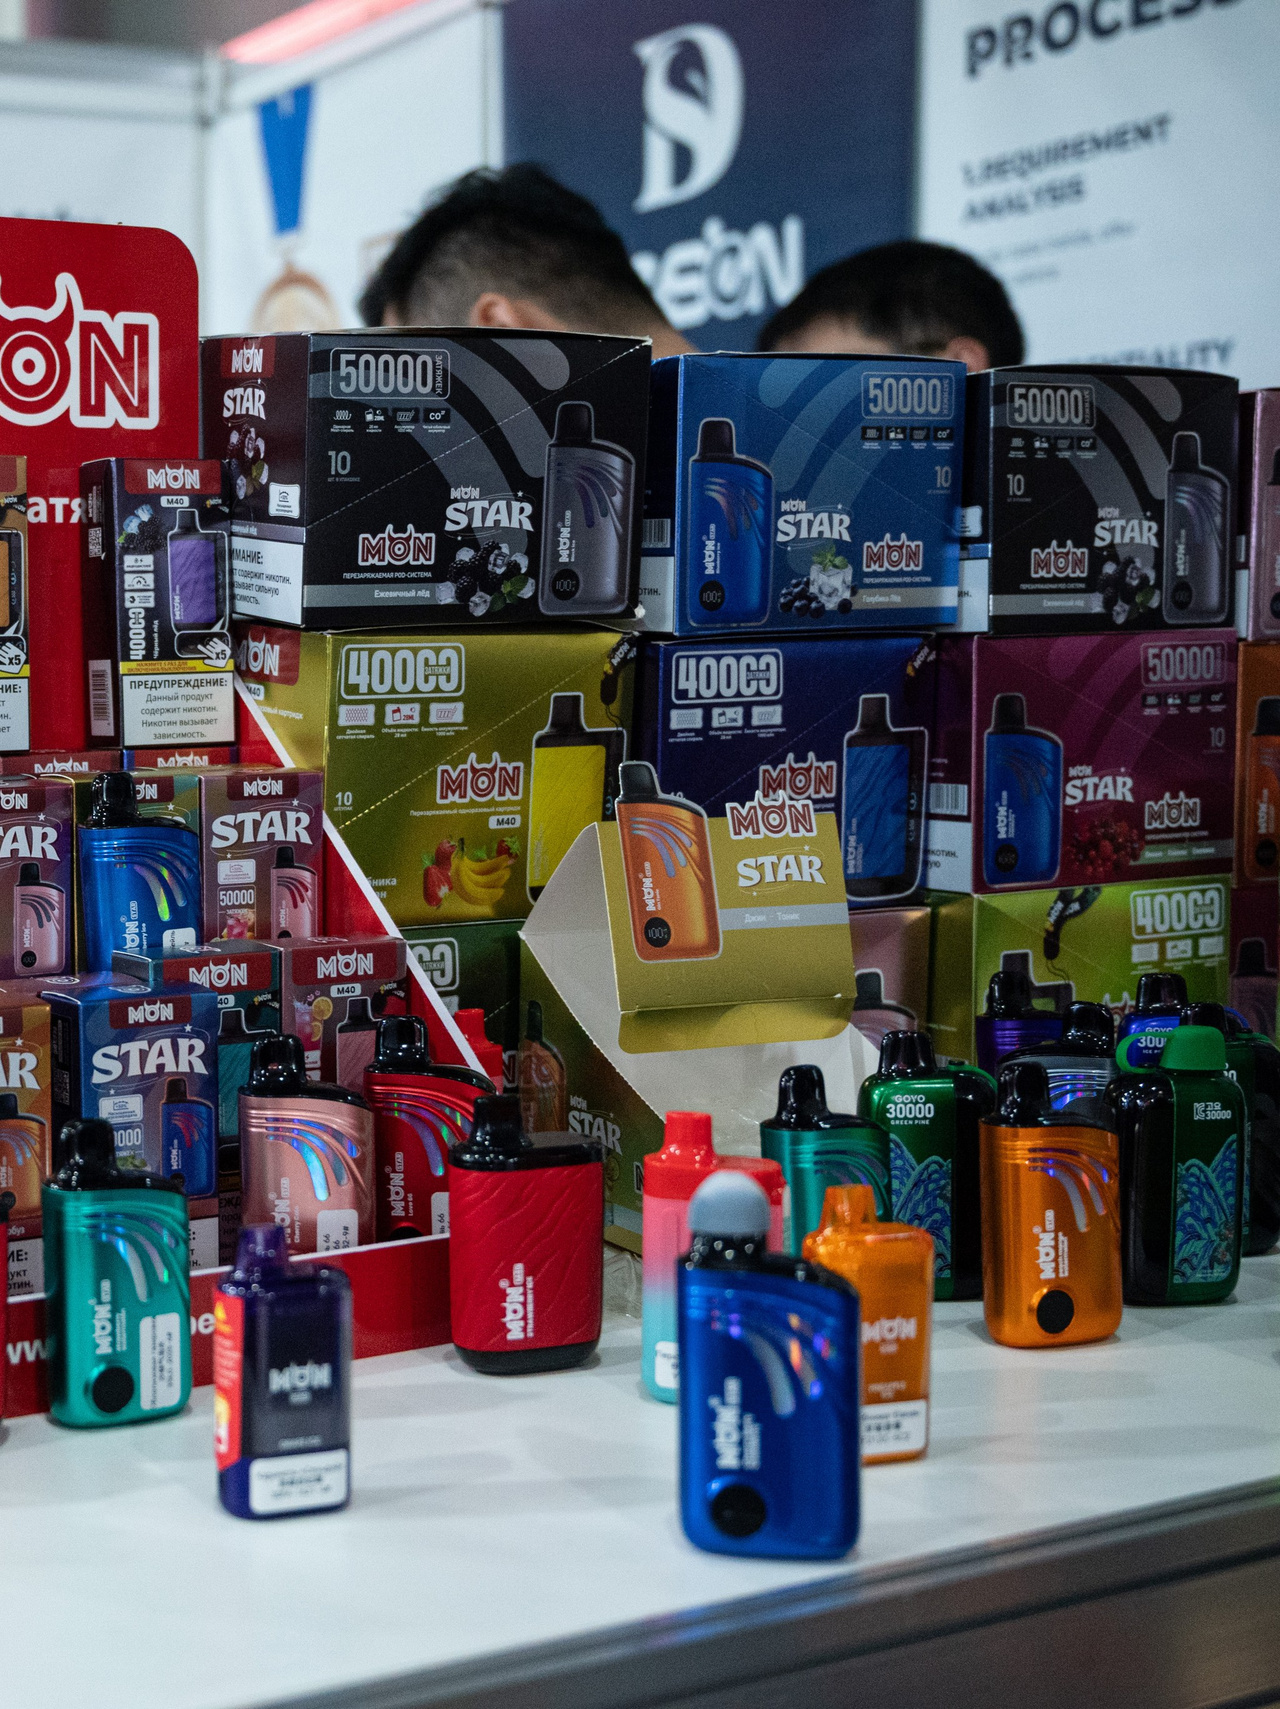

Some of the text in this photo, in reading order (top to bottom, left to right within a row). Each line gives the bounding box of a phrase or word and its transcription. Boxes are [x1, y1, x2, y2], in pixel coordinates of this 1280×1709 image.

[965, 0, 1238, 79] PROCE
[232, 345, 263, 373] MON
[339, 353, 433, 394] 50000
[435, 354, 443, 395] ЗАТЯЖЕК
[222, 387, 266, 420] STAR
[868, 377, 941, 415] 50000
[1013, 388, 1083, 424] 50000
[147, 463, 200, 489] MON
[328, 450, 351, 475] 10
[934, 465, 952, 488] 10
[1007, 474, 1025, 496] 10
[444, 500, 534, 532] STAR
[776, 511, 851, 543] STAR
[358, 524, 435, 566] MON
[1093, 519, 1159, 548] STAR
[863, 532, 923, 572] MON
[1031, 539, 1088, 578] MON
[238, 568, 291, 585] содержит никотин.
[255, 584, 279, 597] сильную
[374, 589, 430, 599] Ежевичный лёд
[1147, 646, 1215, 682] 50000
[130, 678, 227, 691] ПРЕДУПРЕЖДЕНИЕ:
[243, 777, 283, 796] MON
[436, 752, 524, 804] MON
[759, 751, 837, 799] MON
[1064, 775, 1134, 806] STAR
[335, 791, 353, 806] 10
[1144, 790, 1201, 830] MON
[211, 811, 313, 848] STAR
[496, 817, 516, 826] M40
[725, 790, 817, 840] MON
[736, 854, 826, 887] STAR
[220, 889, 254, 907] 50000
[776, 912, 800, 921] Тоник
[188, 959, 247, 989] MON
[316, 948, 373, 979] MON
[336, 986, 356, 995] M40
[128, 1000, 174, 1024] MON
[91, 1037, 209, 1084] STAR
[886, 1103, 935, 1119] 30000
[894, 1094, 926, 1103] GOYO
[1205, 1110, 1232, 1120] 30000
[387, 1172, 405, 1217] MON
[1035, 1232, 1056, 1279] MON
[93, 1303, 113, 1355] MON
[501, 1286, 525, 1340] MON
[269, 1360, 332, 1394] MON
